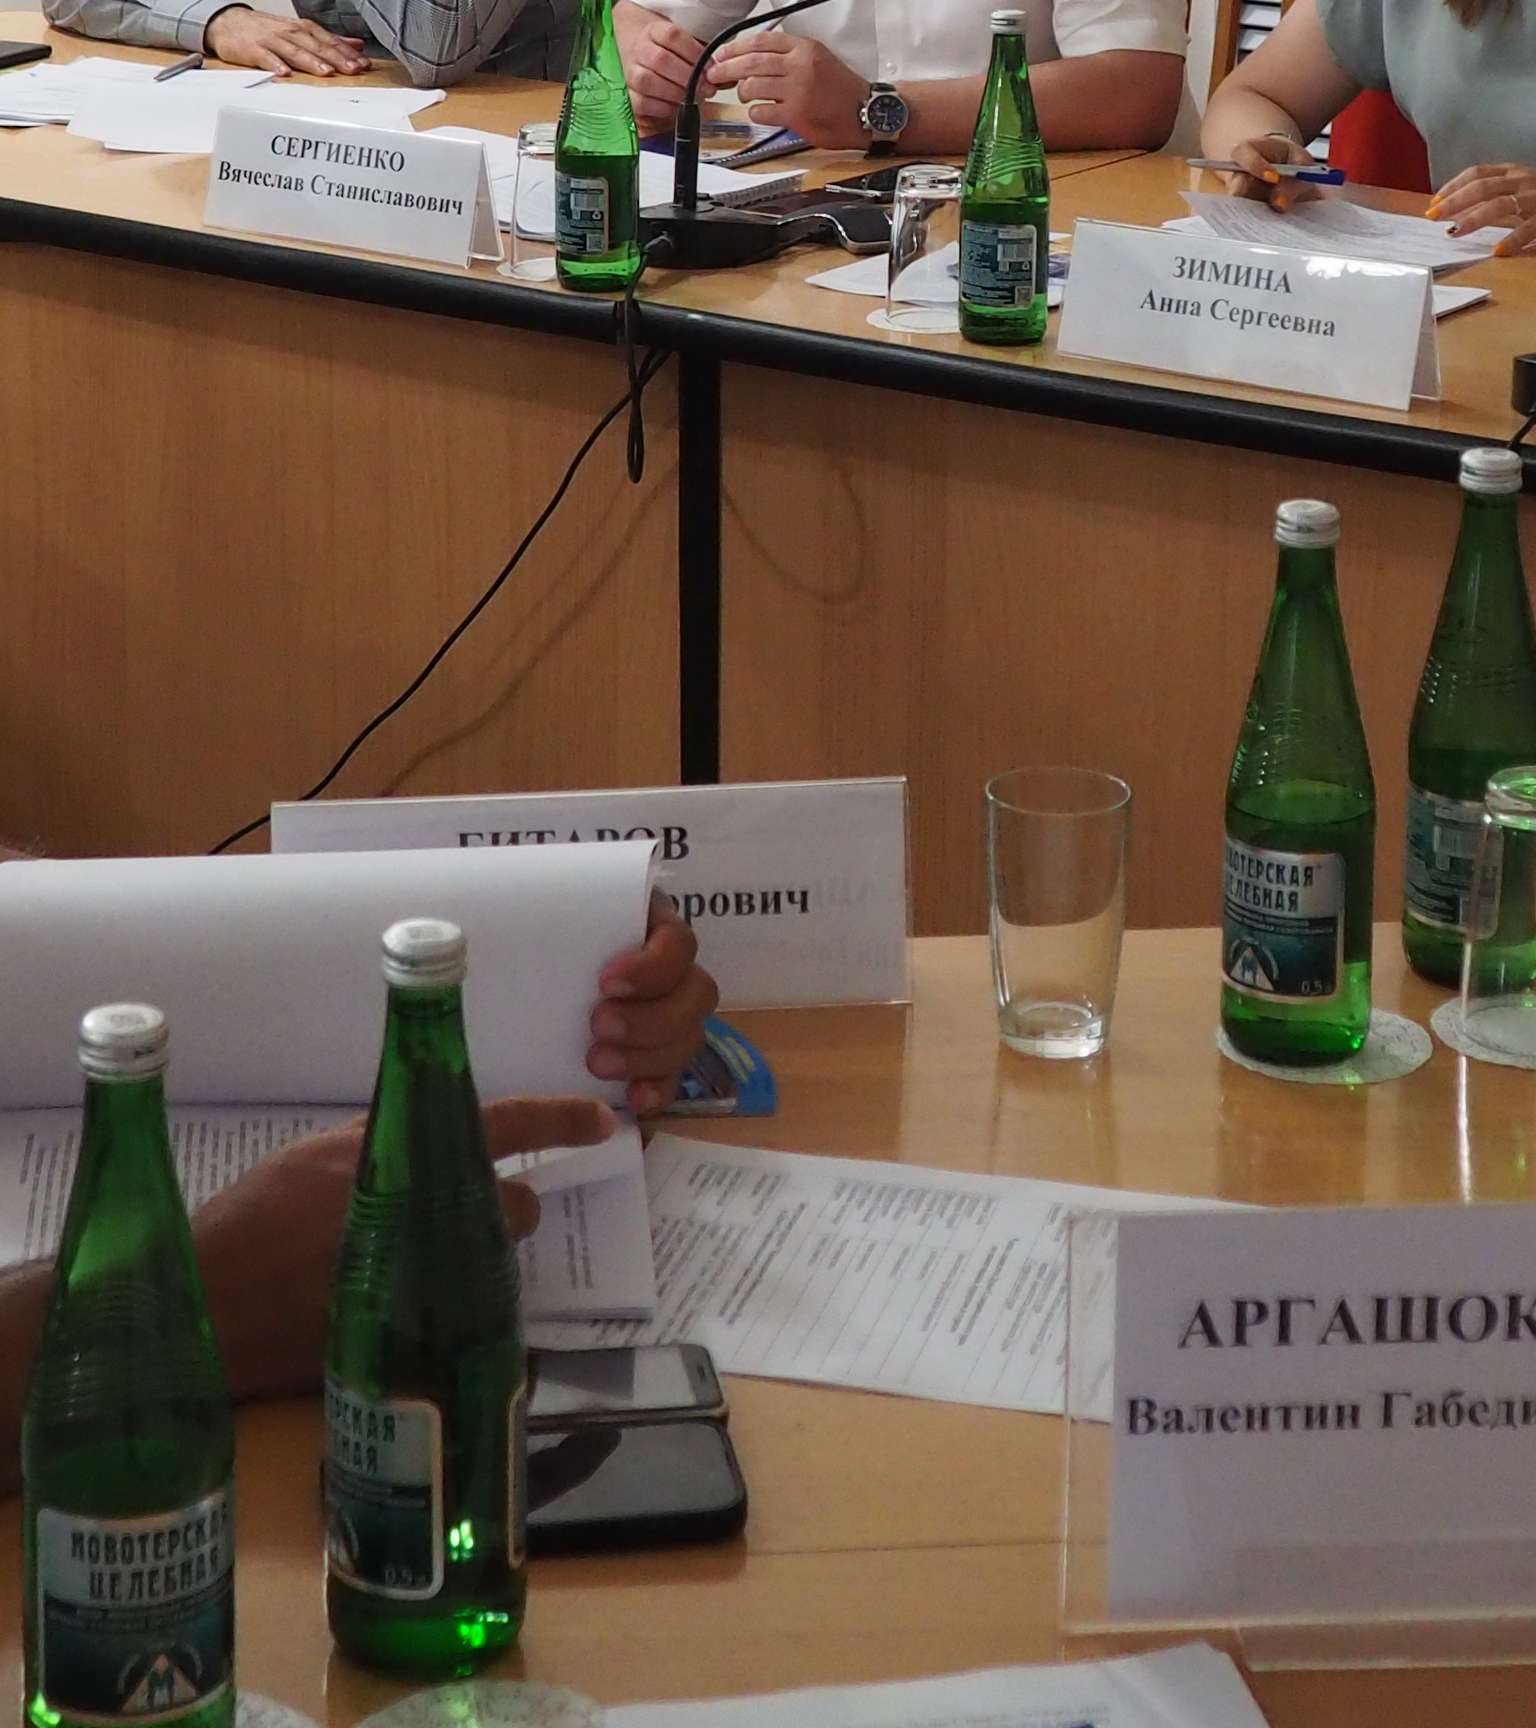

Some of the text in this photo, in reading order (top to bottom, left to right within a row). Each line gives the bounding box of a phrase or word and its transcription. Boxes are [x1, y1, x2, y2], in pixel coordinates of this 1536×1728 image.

[270, 134, 406, 172] СЕРГИЕНКО
[217, 160, 464, 216] Вячеслав Станиславович
[1172, 256, 1292, 294] ЗИМИНА
[1140, 289, 1336, 337] Анна Сергеевна
[1126, 1394, 1362, 1436] Валентин
